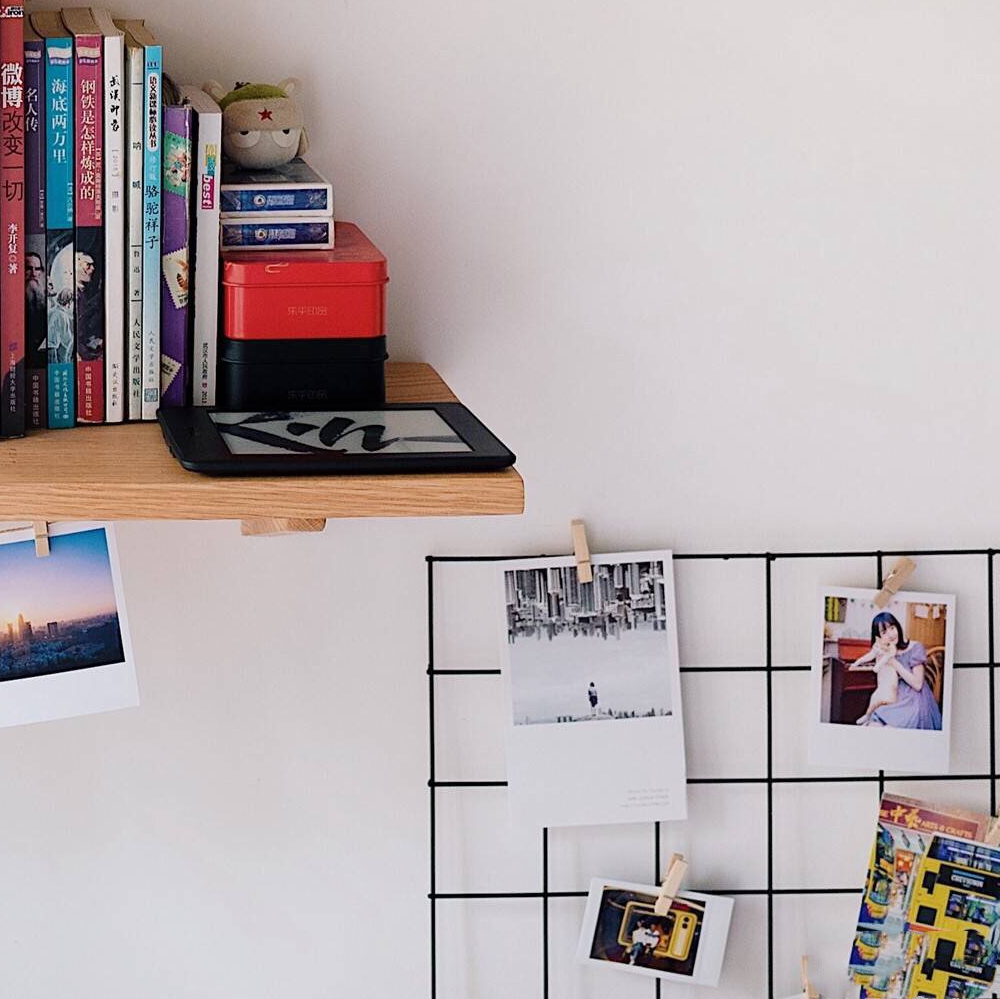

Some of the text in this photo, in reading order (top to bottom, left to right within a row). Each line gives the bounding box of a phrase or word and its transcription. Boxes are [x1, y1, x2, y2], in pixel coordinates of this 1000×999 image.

[1, 63, 24, 201] 微博改变一切
[25, 88, 38, 132] 名人传
[52, 79, 67, 164] 海底两万里
[80, 79, 95, 200] 钢铁是怎样炼成的
[145, 185, 159, 249] 骆驼祥子
[134, 289, 140, 297] 著
[132, 318, 140, 398] 人民文学出版社
